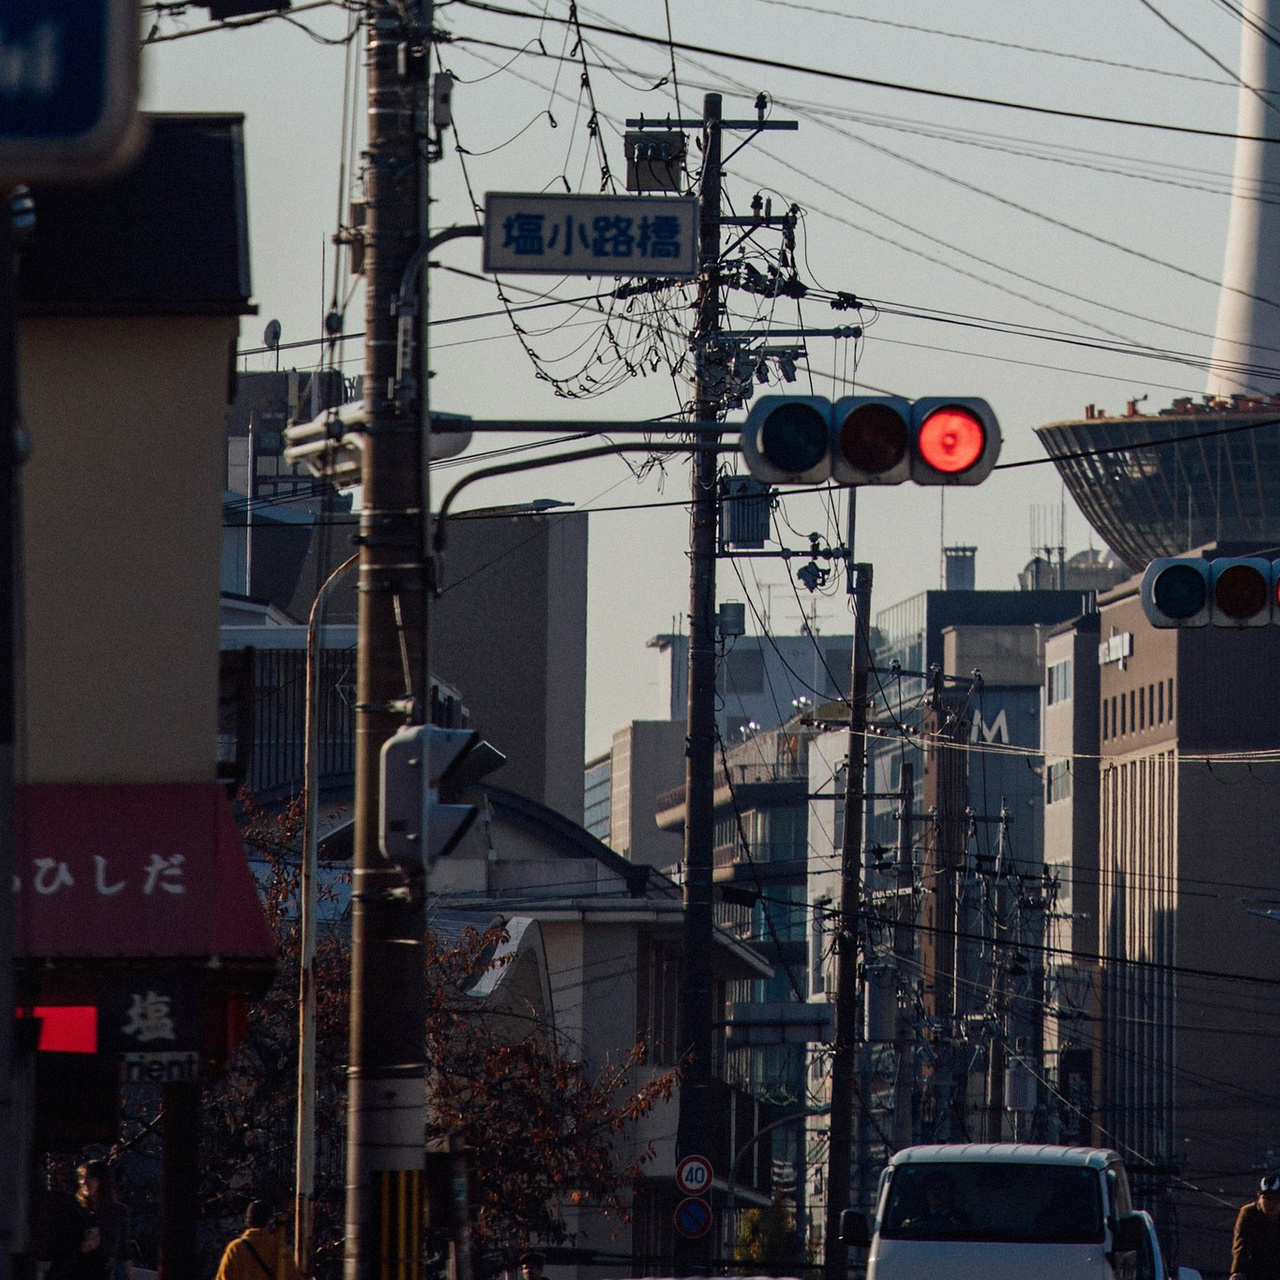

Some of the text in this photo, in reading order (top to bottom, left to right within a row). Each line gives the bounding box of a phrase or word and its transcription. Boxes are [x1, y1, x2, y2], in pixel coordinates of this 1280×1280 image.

[502, 213, 681, 258] 塩小路橋
[12, 853, 185, 895] ひしだ
[685, 1166, 705, 1184] 40
